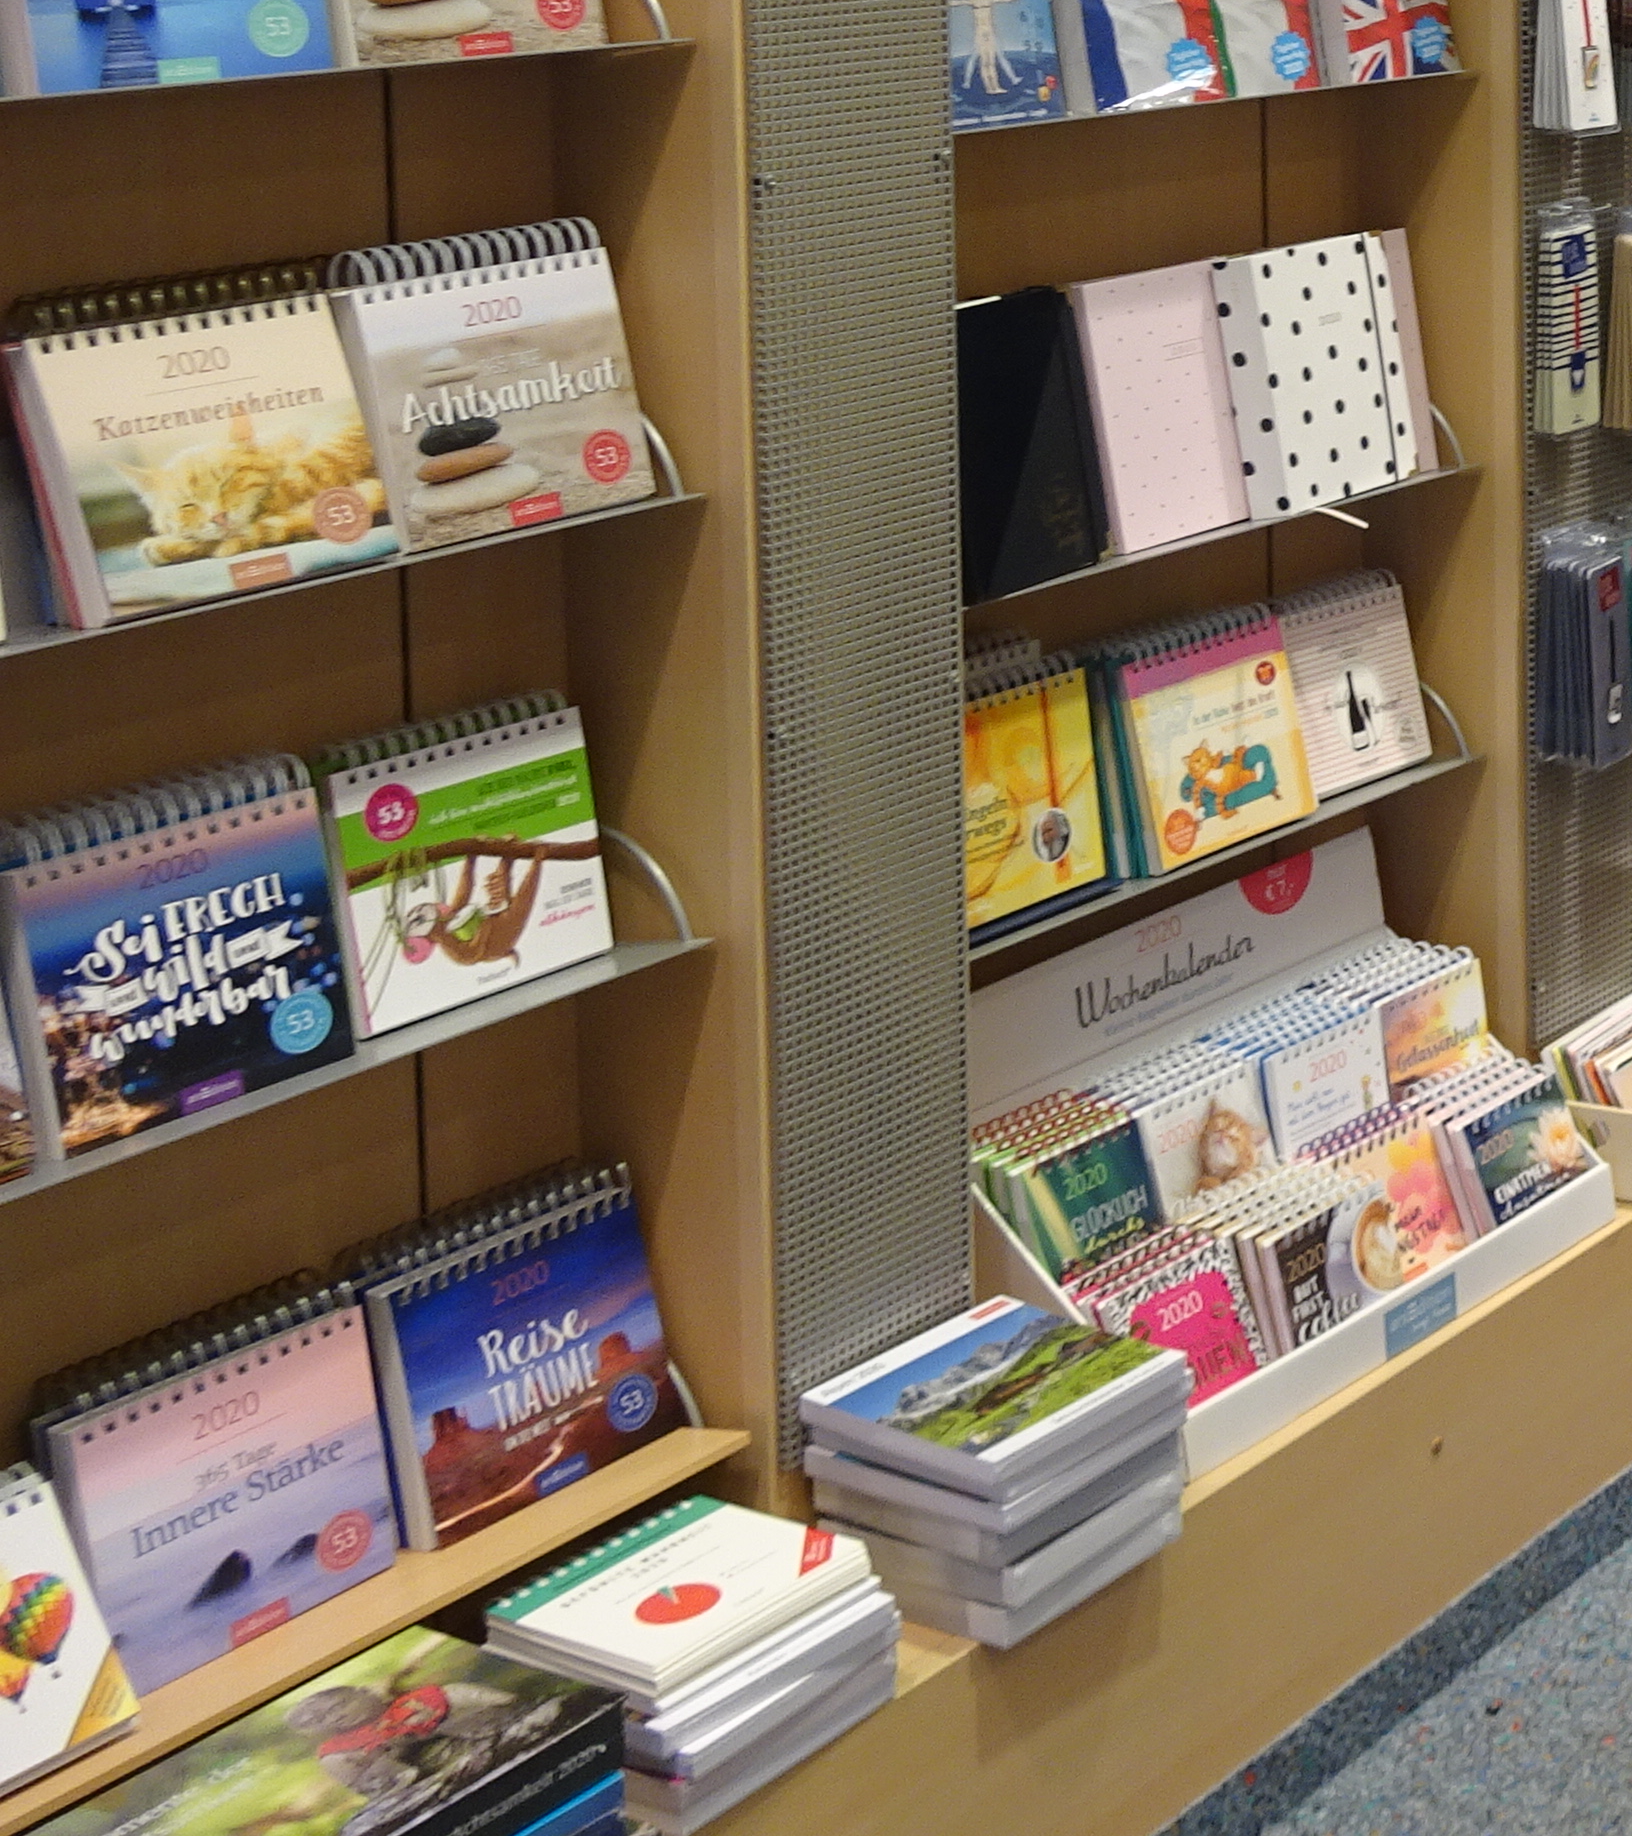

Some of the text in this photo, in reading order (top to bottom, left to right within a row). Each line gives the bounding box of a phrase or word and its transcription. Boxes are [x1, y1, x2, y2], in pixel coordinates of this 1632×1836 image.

[264, 16, 292, 39] 53
[462, 295, 522, 327] 2020
[156, 344, 231, 380] 2020
[93, 382, 325, 444] Katzenweisheiten
[400, 354, 624, 435] Achtsamkeit
[592, 443, 619, 468] 53
[327, 503, 358, 527] 53
[376, 801, 406, 825] 53
[62, 872, 286, 983] Sei FRECH
[1134, 914, 1183, 954] 2020
[142, 933, 230, 1004] wild
[1074, 933, 1256, 1029] Wochenkalender
[89, 963, 291, 1063] wunderbar
[287, 1009, 315, 1035] 53
[1309, 1048, 1347, 1084] 2020
[1063, 1162, 1109, 1202] 2020
[1071, 1183, 1148, 1241] GLÜCKLICH
[492, 1260, 550, 1306] 2020
[1286, 1243, 1326, 1284] 2020
[1292, 1274, 1319, 1303] BUT
[1156, 1290, 1204, 1333] 2020
[476, 1305, 591, 1379] Reise
[486, 1346, 602, 1434] TRÄUME
[619, 1391, 645, 1416] 53
[191, 1391, 261, 1441] 2020
[194, 1440, 277, 1494] 365 Tage
[130, 1436, 346, 1560] Innere Stärke
[331, 1528, 359, 1554] 53
